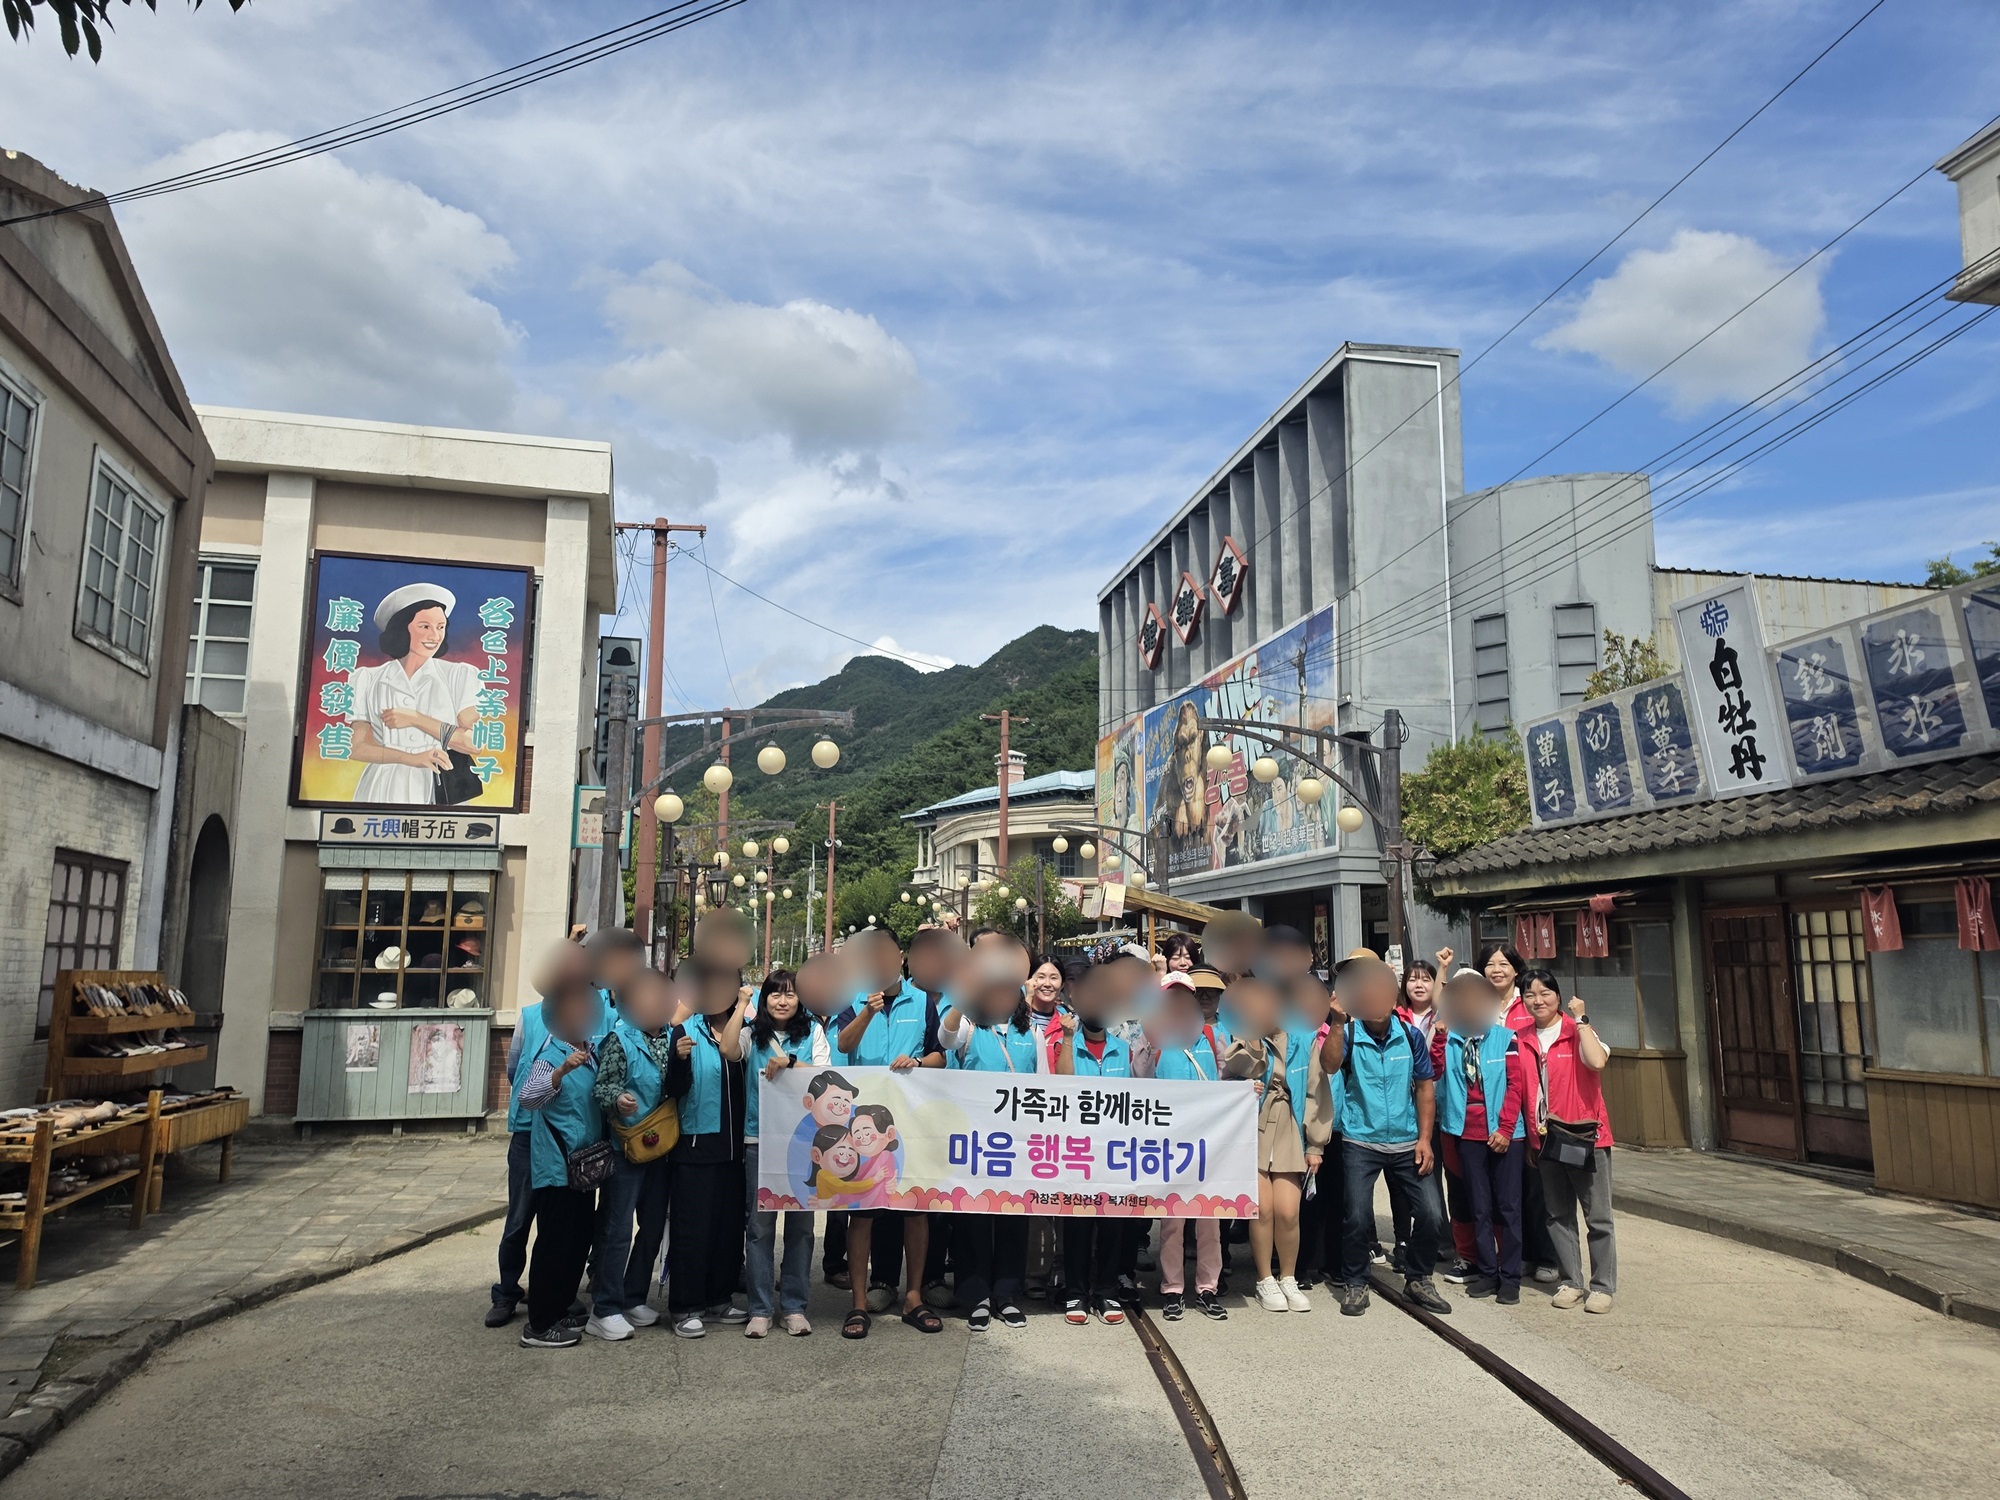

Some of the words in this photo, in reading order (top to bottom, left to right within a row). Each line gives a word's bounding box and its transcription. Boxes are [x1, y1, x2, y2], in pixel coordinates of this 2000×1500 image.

[317, 596, 364, 760] 廉價發售
[470, 596, 514, 784] 各色上等帽子
[1709, 637, 1767, 781] 白牡丹
[1536, 730, 1565, 812] 菓子
[1585, 713, 1621, 802] 砂糖
[362, 818, 458, 839] 元興帽子店
[993, 1086, 1070, 1123] 가족과
[1077, 1090, 1173, 1127] 함께하는
[949, 1130, 1017, 1178] 마음
[1026, 1133, 1095, 1181] 행복
[1106, 1136, 1206, 1183] 더하기
[1029, 1192, 1060, 1205] 거창군
[1062, 1193, 1103, 1206] 정신건강
[1108, 1195, 1149, 1208] 복지센터
